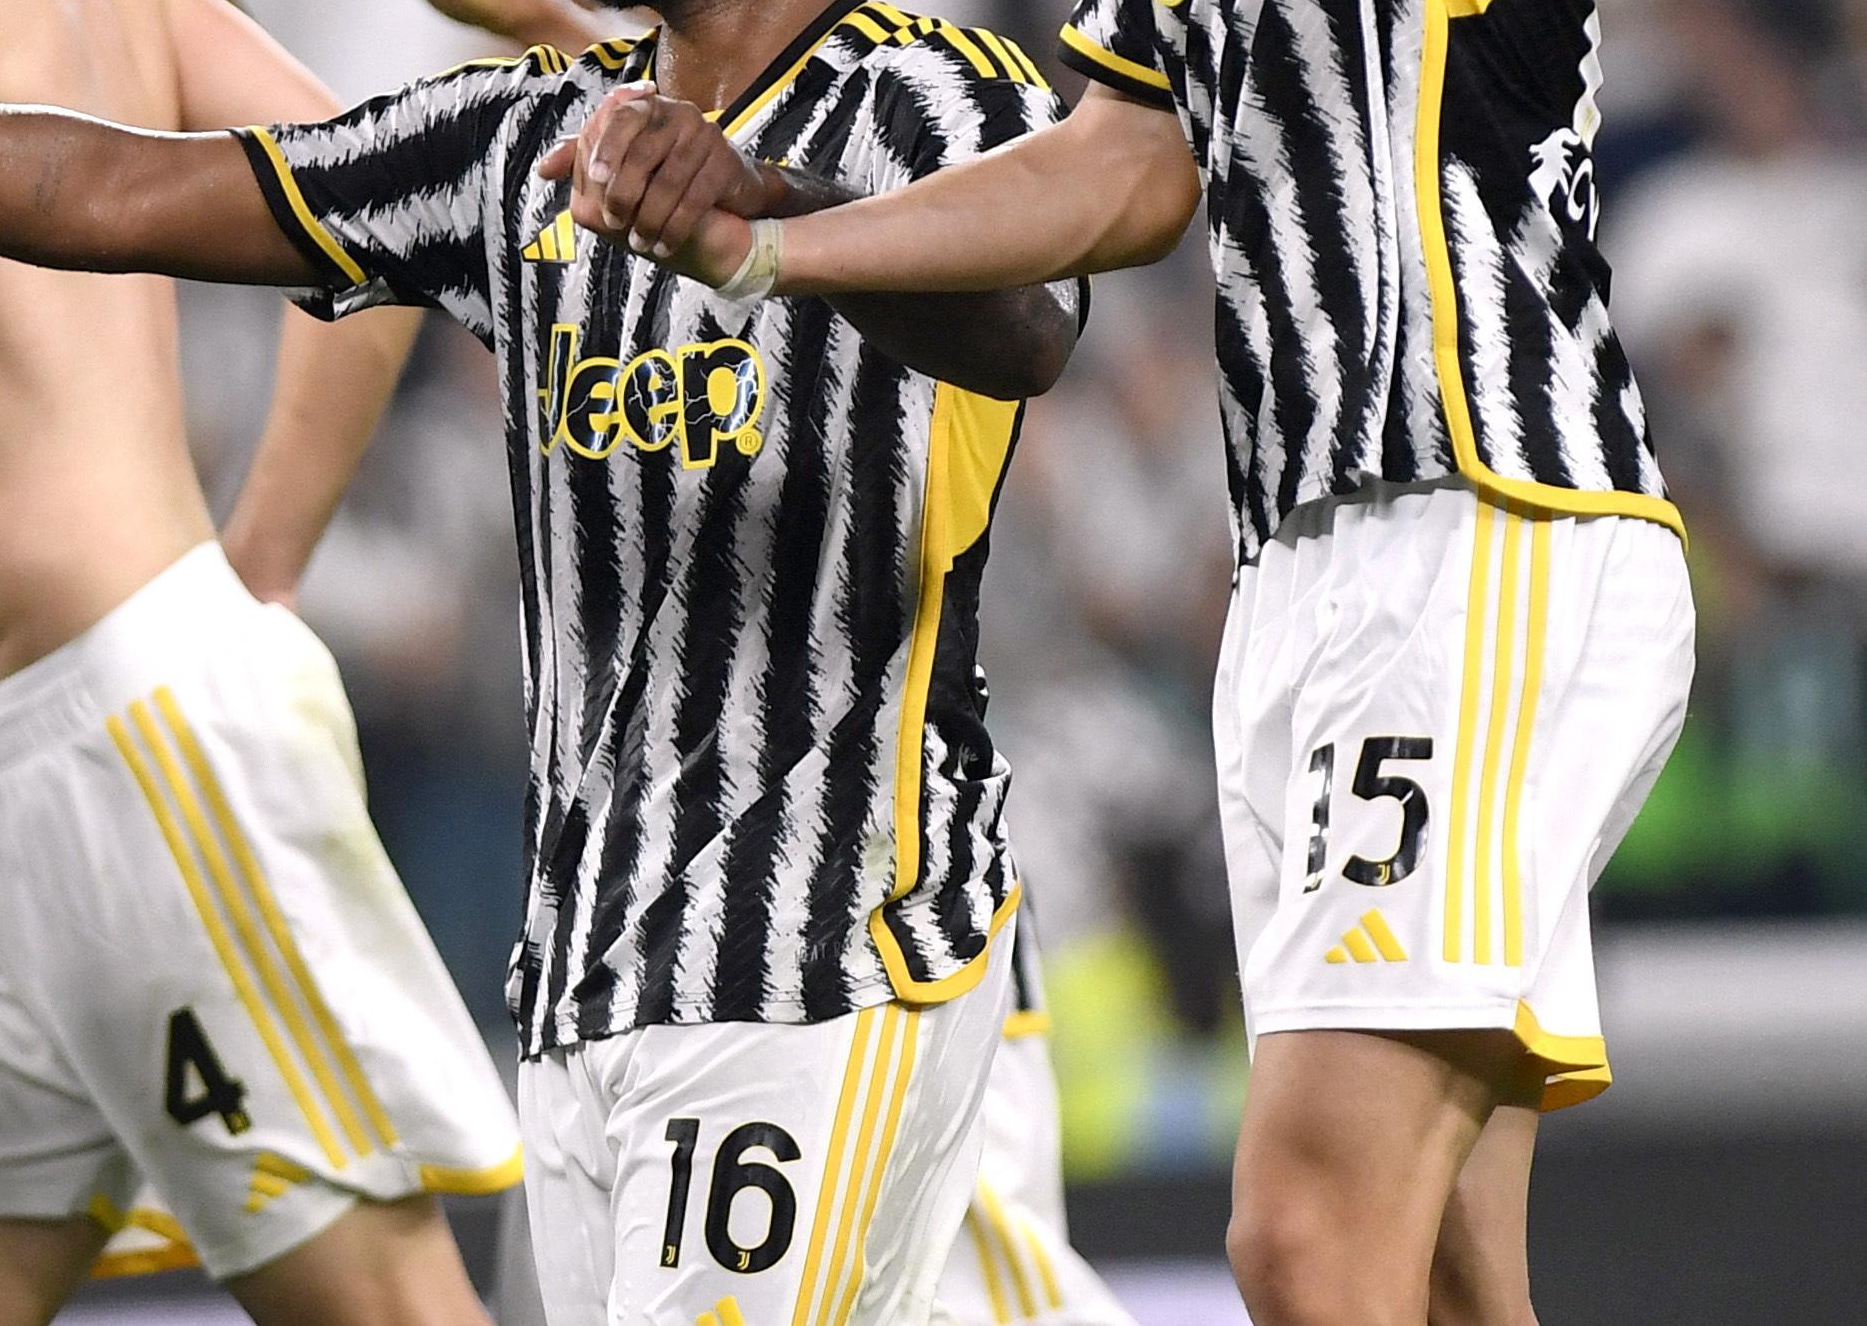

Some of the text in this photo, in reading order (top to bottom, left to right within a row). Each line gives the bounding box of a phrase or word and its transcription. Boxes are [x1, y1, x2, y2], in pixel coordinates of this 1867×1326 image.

[537, 323, 765, 469] Jeep
[1302, 736, 1433, 894] 15
[166, 1005, 252, 1135] 4
[660, 1118, 802, 1273] 16
